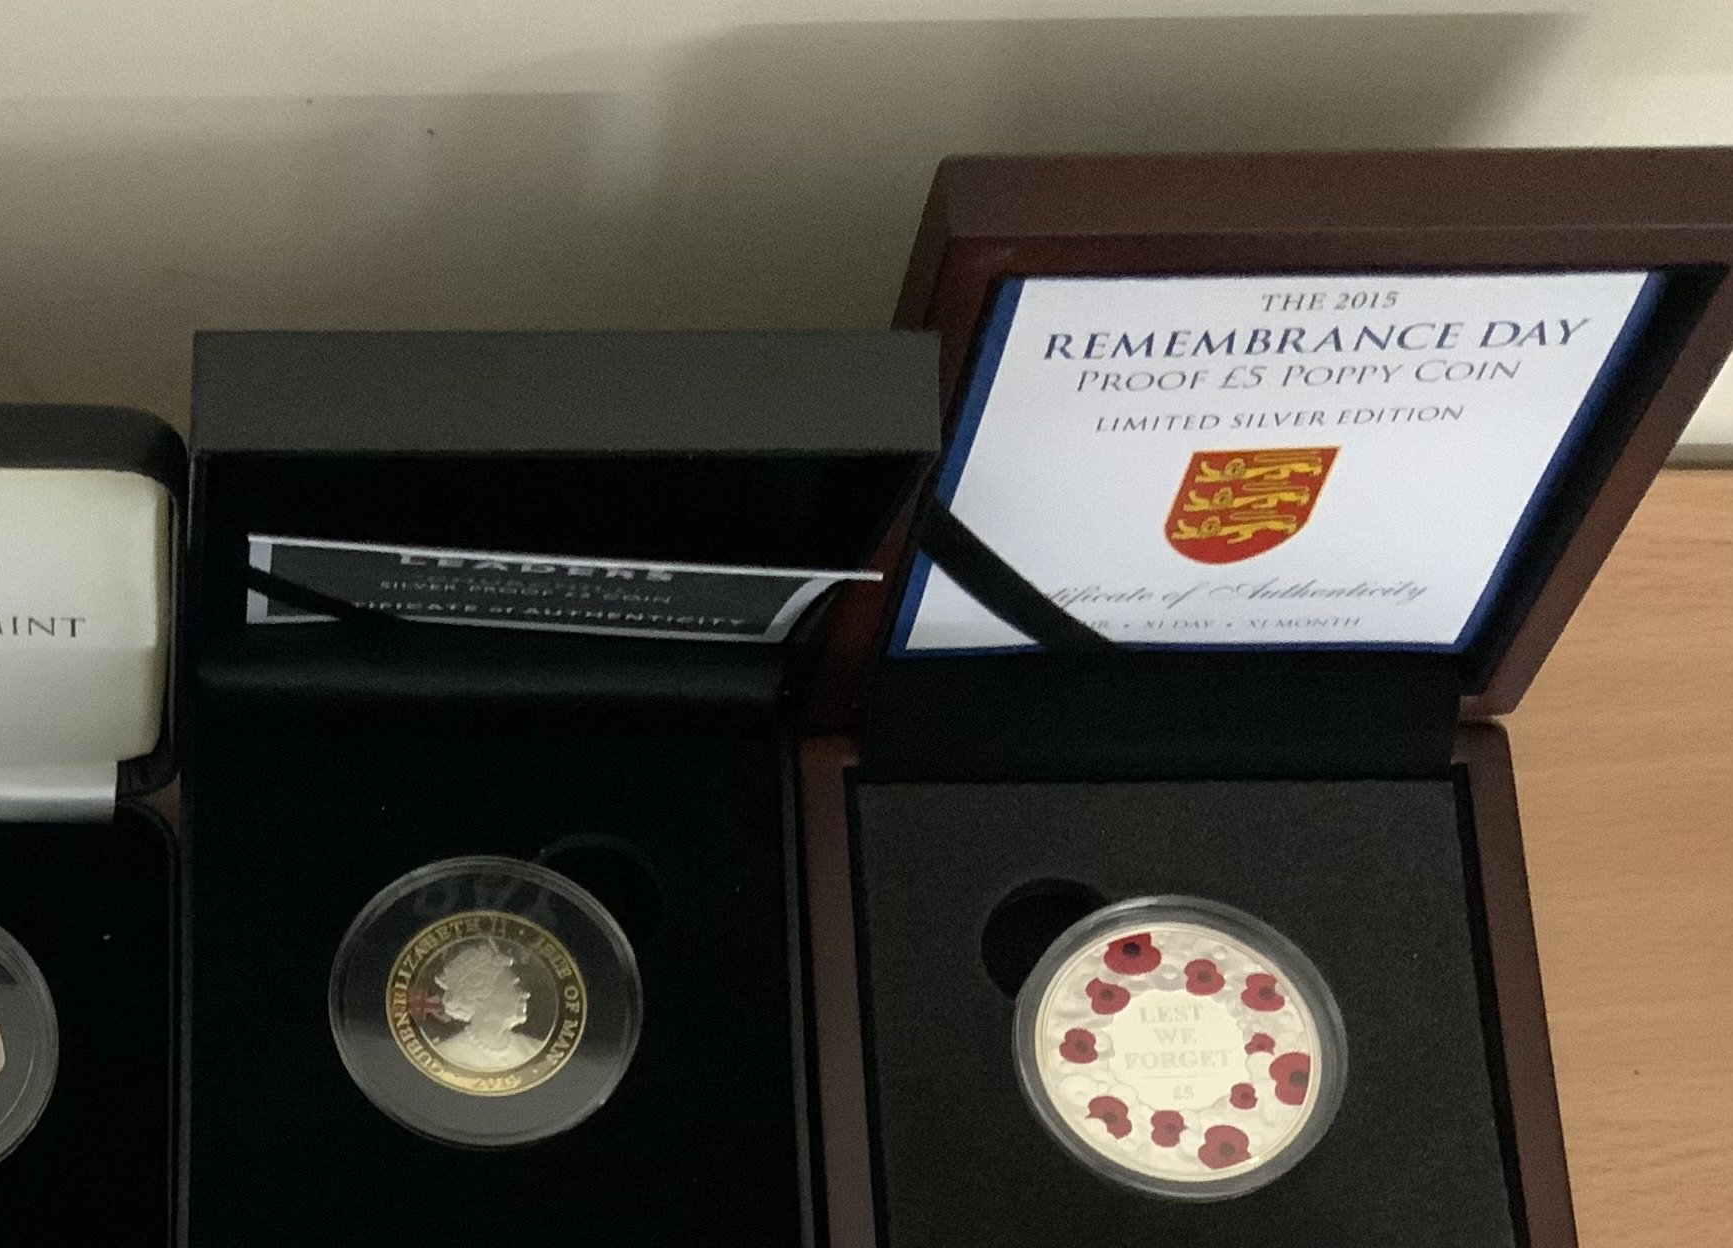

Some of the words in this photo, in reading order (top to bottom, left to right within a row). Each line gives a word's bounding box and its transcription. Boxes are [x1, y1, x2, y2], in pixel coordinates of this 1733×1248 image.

[1261, 292, 1327, 312] THE
[1334, 291, 1399, 310] 2015
[1044, 324, 1460, 361] REMEMBRANCE
[1480, 318, 1592, 348] DAY
[1077, 367, 1210, 392] PROOF
[1219, 366, 1268, 390] £5
[1282, 363, 1404, 388] POPPY
[1416, 359, 1522, 383] COIN
[1096, 413, 1221, 433] LIMITED
[1231, 410, 1326, 429] SILVER
[1338, 405, 1465, 425] EDITION
[1049, 585, 1154, 607] tificate
[1161, 581, 1210, 609] of
[1209, 578, 1428, 606] Authenticity
[1273, 617, 1361, 628] MONTH
[1139, 1006, 1203, 1024] LEST
[1153, 1028, 1198, 1045] WE
[1123, 1050, 1231, 1070] FORGET
